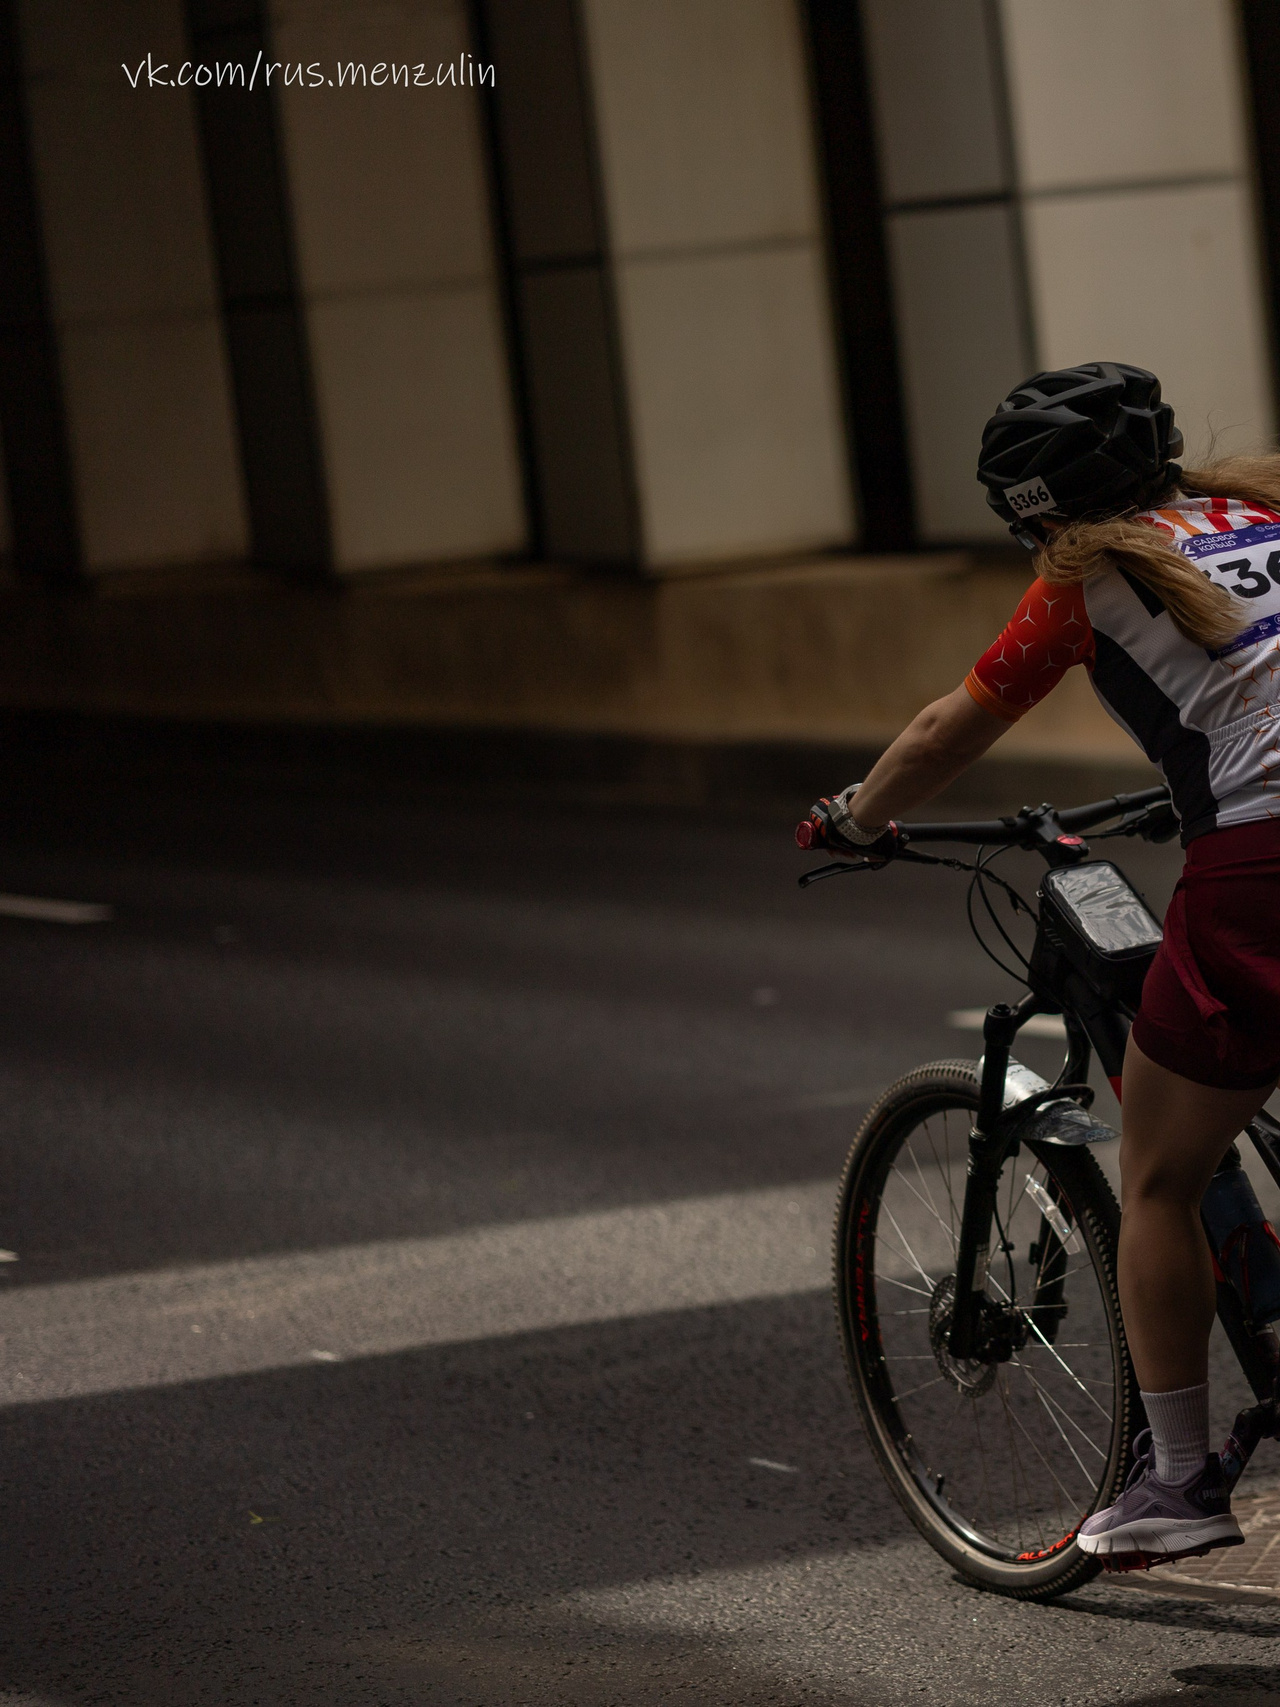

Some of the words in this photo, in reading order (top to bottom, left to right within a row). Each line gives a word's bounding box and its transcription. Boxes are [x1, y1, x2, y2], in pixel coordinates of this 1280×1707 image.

[1009, 485, 1050, 511] 3366
[1192, 532, 1238, 546] САДОВОЕ
[1198, 540, 1237, 553] КОЛЬЦО
